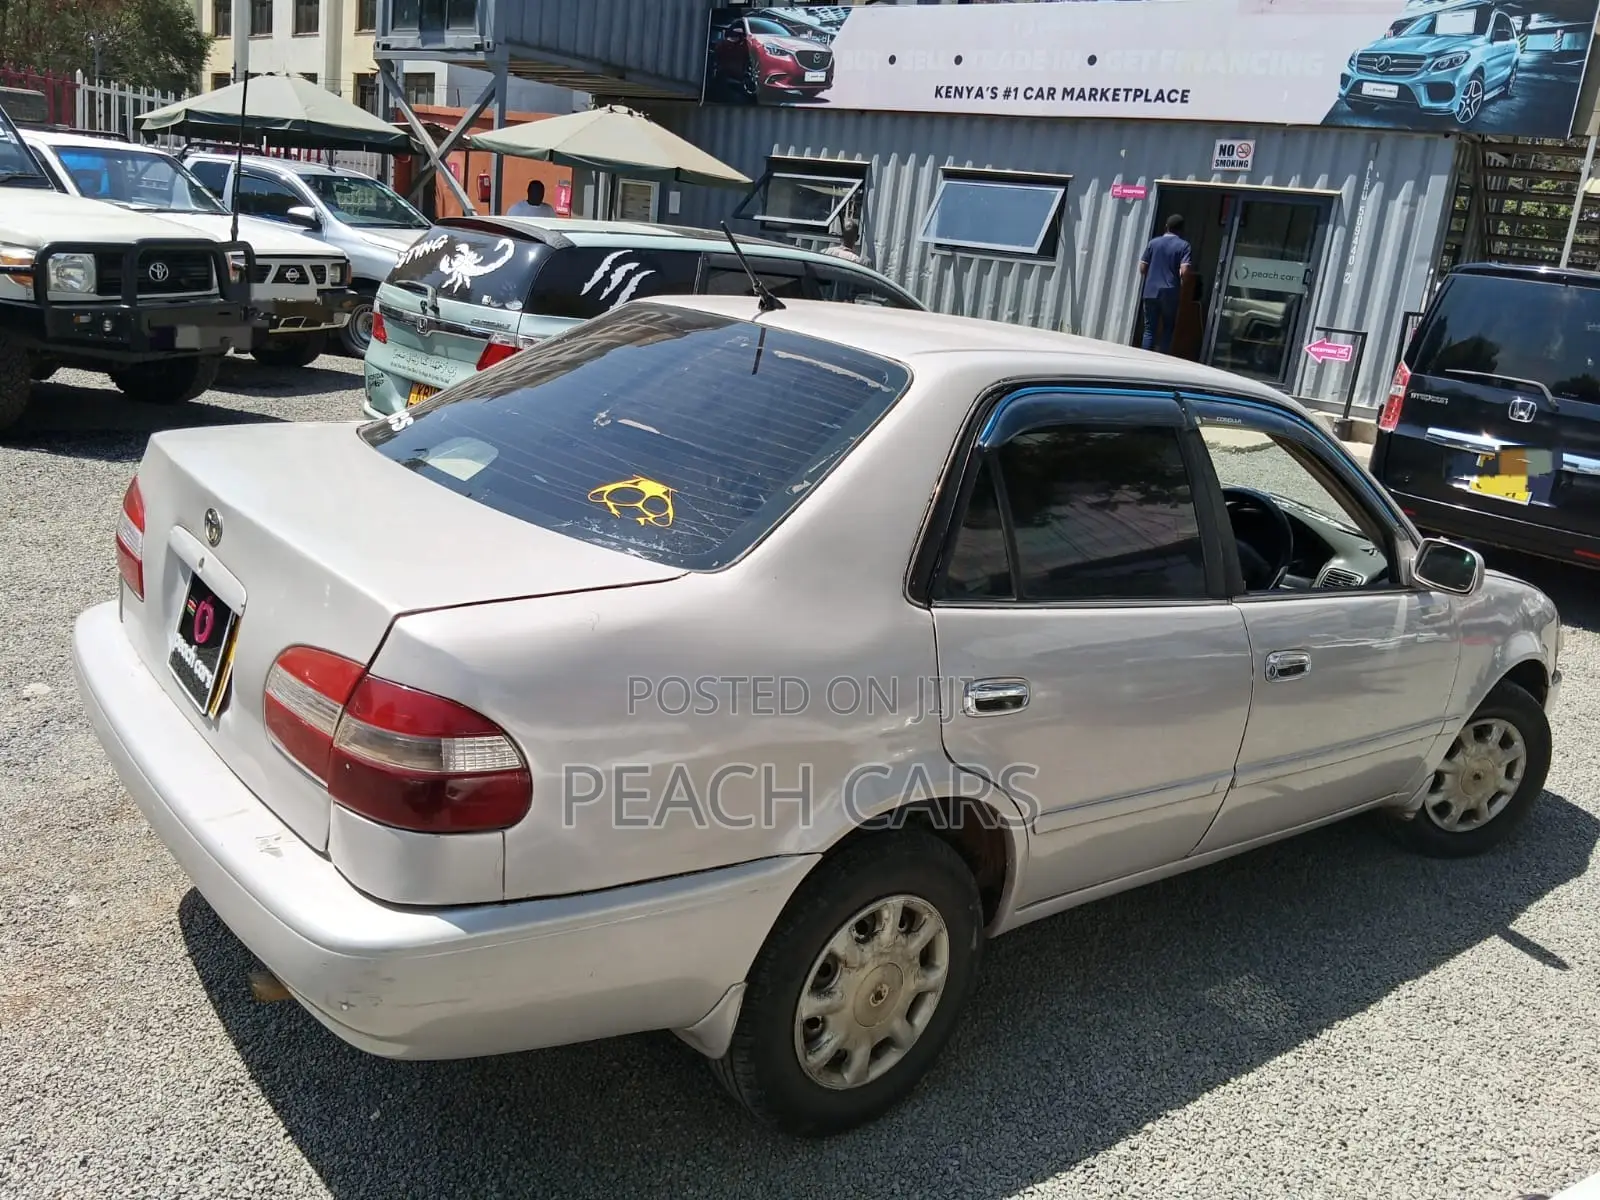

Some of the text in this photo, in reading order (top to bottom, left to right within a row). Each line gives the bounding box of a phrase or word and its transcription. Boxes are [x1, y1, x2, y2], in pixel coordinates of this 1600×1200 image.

[1105, 50, 1156, 73] GET
[1160, 50, 1324, 77] FINANCING
[934, 85, 1191, 104] KENYA'S #1 CAR MARKETPLACE
[1219, 143, 1235, 157] NO
[1214, 158, 1249, 169] SMOKING
[1251, 269, 1279, 281] peach
